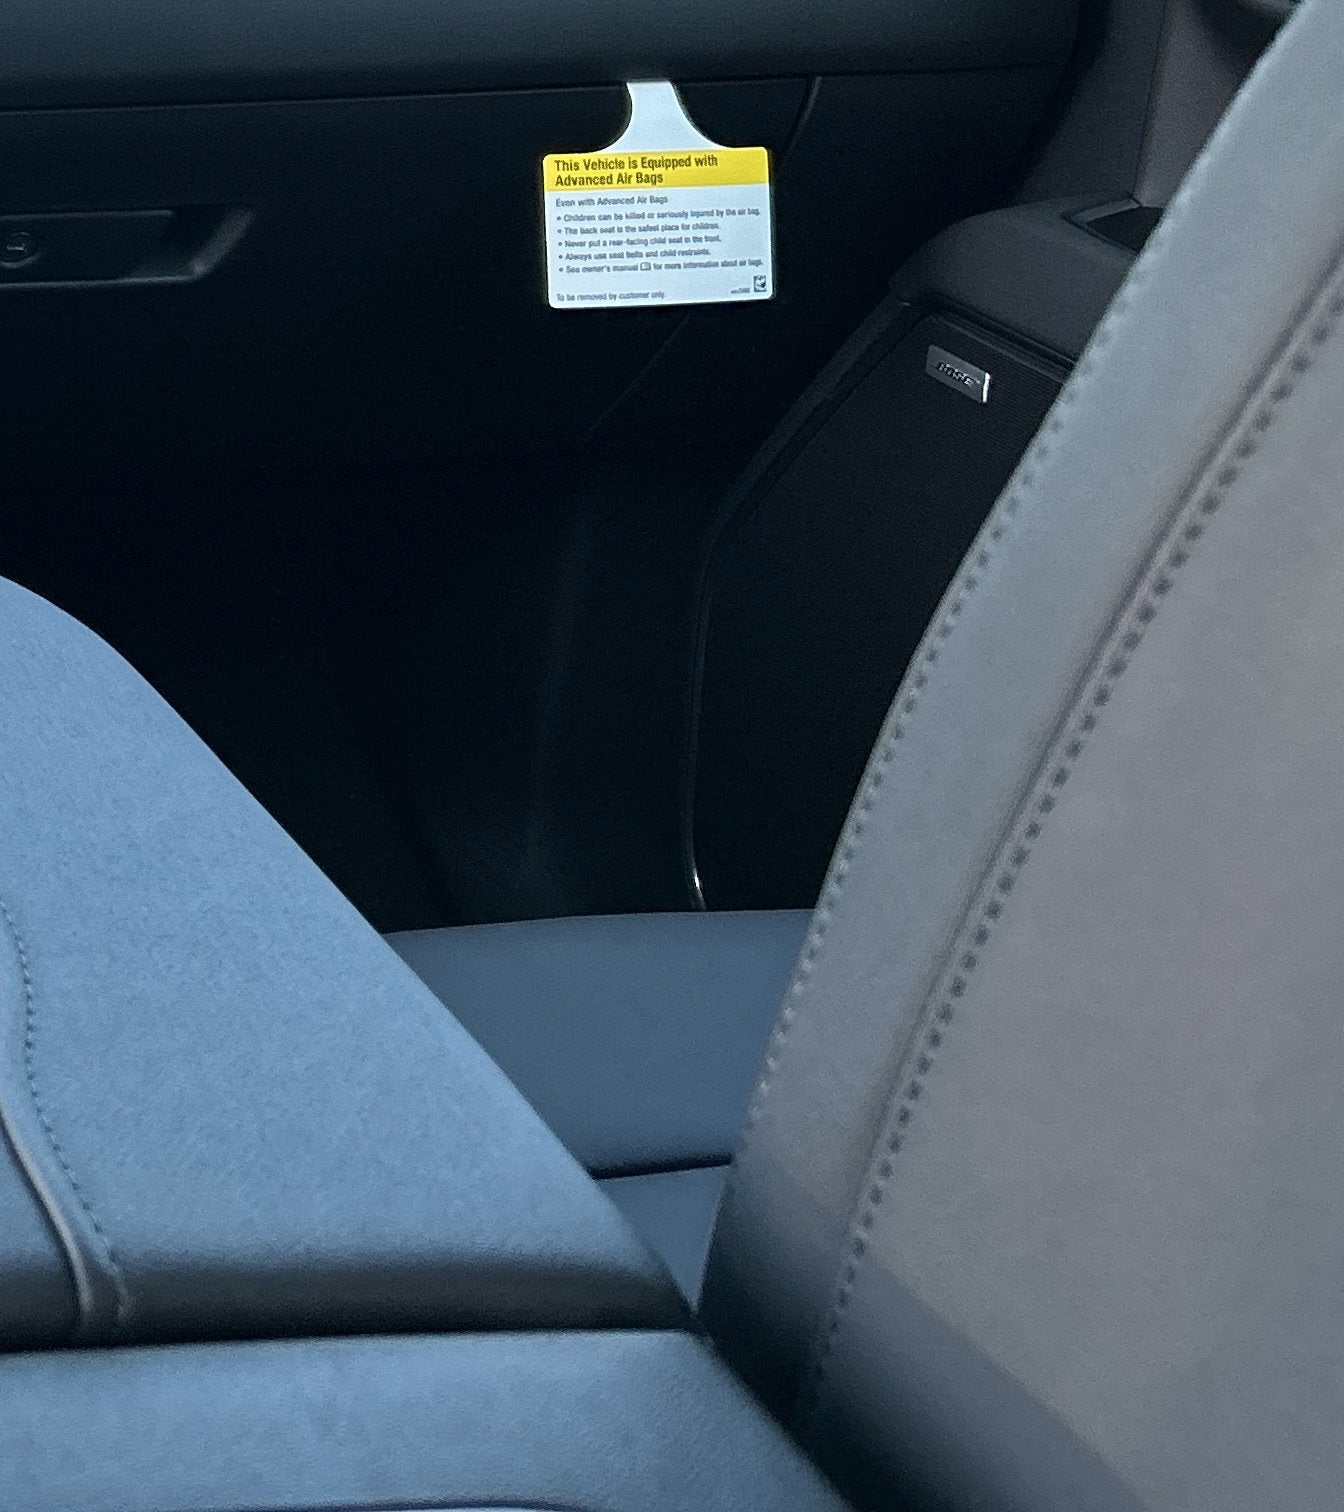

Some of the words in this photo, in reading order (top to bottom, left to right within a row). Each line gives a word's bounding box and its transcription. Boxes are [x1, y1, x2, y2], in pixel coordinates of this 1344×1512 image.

[554, 159, 580, 172] This
[583, 157, 625, 171] Vehicle
[628, 156, 638, 169] is
[641, 155, 692, 171] Equipped
[695, 154, 719, 167] with
[554, 172, 613, 187] Advanced
[616, 172, 633, 185] Air
[635, 171, 664, 186] Bags
[597, 196, 634, 206] Advanced
